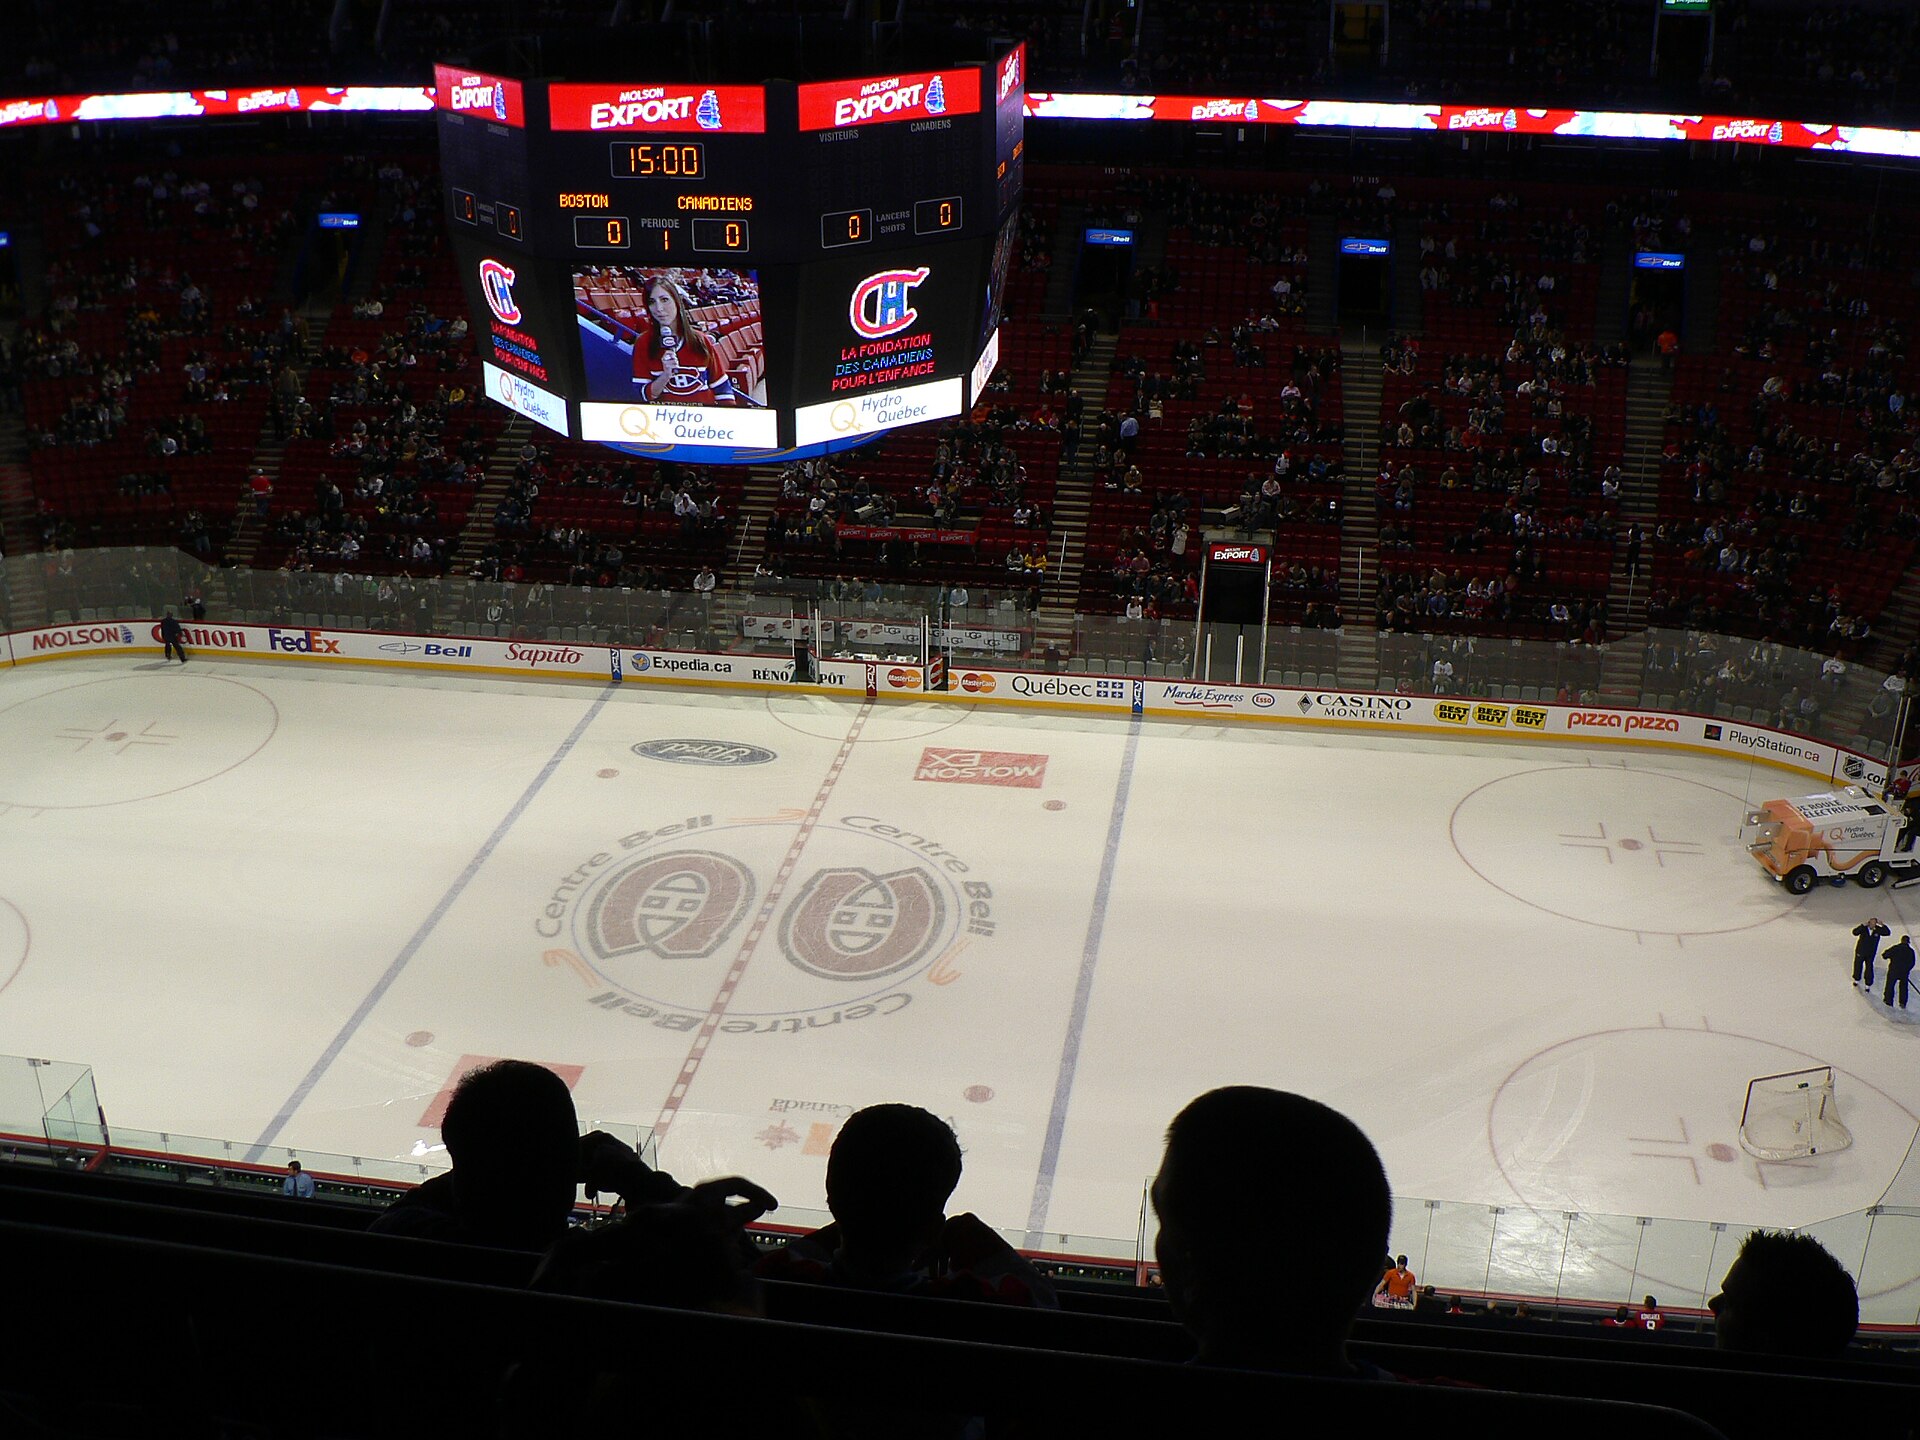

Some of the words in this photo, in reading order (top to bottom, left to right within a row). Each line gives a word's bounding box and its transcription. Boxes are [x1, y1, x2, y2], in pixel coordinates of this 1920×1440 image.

[619, 87, 664, 102] MOLSON
[861, 78, 899, 96] MOLSON
[238, 92, 287, 111] EXPORT
[452, 86, 493, 109] EXPORT
[835, 84, 924, 126] EXPORT
[0, 102, 43, 123] XPORT
[591, 97, 694, 129] EXPORT
[1192, 103, 1244, 119] EXPORT
[910, 119, 951, 132] CANADIENS
[1449, 112, 1504, 129] EXPORT
[819, 130, 859, 143] VISITEURS
[1712, 124, 1769, 140] EXPORT
[629, 146, 698, 175] 15:00
[559, 194, 609, 208] BOSTON
[677, 197, 752, 211] CANADIENS
[876, 210, 911, 223] LANCERS
[941, 203, 951, 225] 0
[607, 220, 621, 244] 0
[641, 218, 680, 229] PERIODE
[849, 215, 860, 238] 0
[880, 223, 906, 234] SHOTS
[663, 231, 668, 250] 1
[726, 223, 740, 247] 0
[841, 348, 857, 360] LA
[860, 334, 931, 358] FONDATION
[836, 361, 860, 376] DES
[862, 348, 933, 371] CANADIENS
[832, 374, 867, 391] POUR
[868, 362, 935, 384] L'ENFANCE
[514, 379, 535, 399] Hydro
[523, 398, 549, 421] Québec
[862, 394, 902, 412] Hydro
[656, 409, 703, 425] Hydro
[877, 405, 927, 423] Québec
[674, 424, 734, 440] Québec
[1214, 551, 1250, 559] EXPORT
[33, 627, 120, 650] MOLSON
[269, 629, 340, 653] FedEx
[424, 644, 472, 657] Bell
[505, 643, 584, 667] Saputo
[653, 657, 731, 672] Expedia.ca
[753, 668, 788, 681] RÉNO
[888, 675, 921, 683] MasterCard
[1012, 676, 1091, 698] Québec
[1163, 685, 1202, 698] Marché
[1204, 689, 1244, 702] Express
[1316, 694, 1411, 710] CASINO
[1438, 704, 1470, 714] BEST
[1324, 707, 1402, 720] MONTRÉAL
[1438, 712, 1465, 721] BUY
[1477, 707, 1508, 717] BEST
[1477, 714, 1503, 724] BUY
[1515, 710, 1547, 719] BEST
[1516, 717, 1542, 726] BUY
[1567, 711, 1621, 729] pizza
[1624, 715, 1679, 732] pizza
[1729, 730, 1820, 762] PlayStation.ca
[926, 752, 981, 768] EX
[918, 765, 1041, 779] MOLSON
[1803, 804, 1863, 819] ÉLECTRIQUE
[1809, 800, 1844, 811] ROULE
[1844, 826, 1864, 835] Hydro
[535, 852, 613, 938] Centre
[618, 814, 713, 849] Bell
[840, 816, 970, 873] Centre
[962, 881, 996, 937] Bell
[588, 991, 702, 1032] Bell
[720, 992, 913, 1033] Centre
[771, 1098, 856, 1118] Canada
